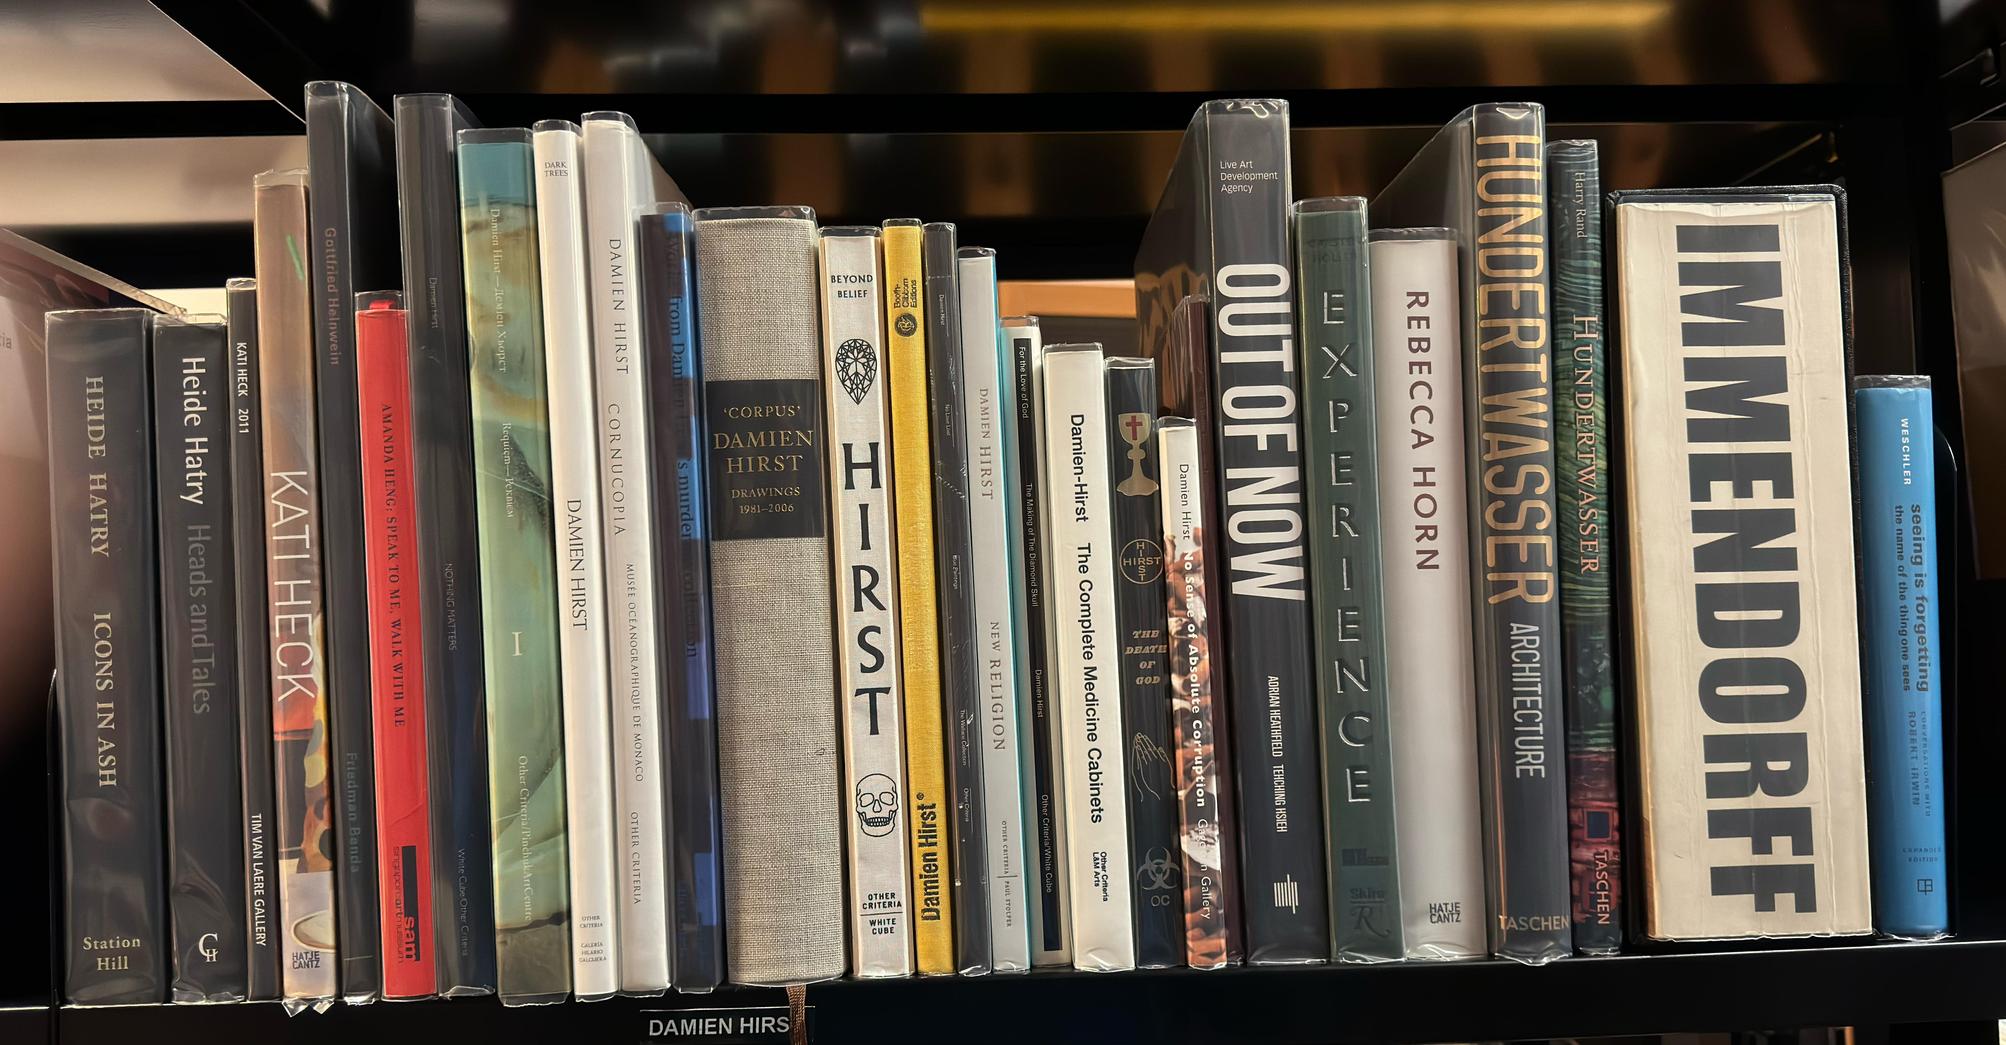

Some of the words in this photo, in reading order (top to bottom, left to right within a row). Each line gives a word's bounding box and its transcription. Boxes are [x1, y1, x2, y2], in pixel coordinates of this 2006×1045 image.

[544, 169, 568, 177] TREES
[1220, 161, 1237, 169] Live
[1240, 160, 1253, 169] Art
[1220, 172, 1278, 181] Development
[1221, 184, 1253, 194] Agency
[1573, 171, 1589, 206] Harry
[490, 208, 501, 246] Damien
[1575, 208, 1589, 239] Rand
[323, 227, 341, 293] Gottfried
[609, 238, 626, 312] DAMIEN
[831, 274, 873, 283] BEYOND
[838, 289, 868, 298] BELIEF
[667, 296, 683, 336] from
[1216, 263, 1293, 373] OUT
[236, 342, 248, 365] KATI
[613, 322, 629, 375] HIRST
[1018, 346, 1027, 359] For
[237, 368, 249, 397] HECK
[1019, 360, 1027, 373] the
[1020, 374, 1028, 392] Love
[1405, 291, 1436, 451] REBECCA
[1475, 134, 1554, 605] HUNDERTWASSER
[181, 357, 208, 427] Heide
[86, 375, 107, 459] HEIDE
[238, 408, 250, 434] 2011
[979, 388, 992, 439] DAMIEN
[1021, 403, 1029, 420] God
[1221, 385, 1298, 453] OF
[381, 403, 396, 463] AMANDA
[713, 430, 814, 450] DAMIEN
[1573, 314, 1600, 575] HUNDERTWASSER
[726, 455, 804, 474] HIRST
[1070, 413, 1089, 523] Damien-Hirst
[1900, 417, 1912, 486] WESCHLER
[179, 436, 209, 504] Hatry
[607, 403, 627, 537] CORNUCOPIA
[979, 446, 995, 500] HIRST
[1178, 464, 1192, 507] Damien
[385, 468, 399, 512] HENG:
[731, 486, 801, 499] DRAWINGS
[1025, 483, 1033, 498] The
[88, 472, 110, 558] HATRY
[271, 470, 312, 561] KATI
[1026, 499, 1035, 526] Making
[1181, 511, 1193, 540] Hirst
[1411, 465, 1441, 571] HORN
[1895, 504, 1907, 524] the
[386, 516, 400, 560] SPEAK
[566, 499, 585, 572] DAMIEN
[1028, 537, 1036, 551] The
[1225, 465, 1307, 602] NOW
[1321, 289, 1372, 804] EXPERIENCE
[1896, 528, 1907, 561] name
[1910, 503, 1927, 566] seeing
[187, 523, 214, 597] Heads
[388, 566, 402, 584] TO
[1029, 553, 1038, 587] Diamond
[1077, 542, 1092, 575] The
[1123, 556, 1161, 567] HIRST
[1183, 551, 1195, 571] No
[1675, 223, 1818, 914] IMMENDORFF
[1897, 564, 1909, 578] of
[443, 563, 456, 607] NOTHING
[842, 442, 892, 736] HIRST
[1185, 576, 1199, 618] Sense
[1898, 581, 1910, 600] the
[1914, 573, 1928, 588] is
[388, 588, 403, 614] ME,
[570, 577, 588, 631] HIRST
[1031, 588, 1039, 607] Skull
[189, 604, 215, 647] and
[446, 609, 458, 651] MATTERS
[990, 621, 1002, 652] NEW
[1079, 579, 1097, 661] Complete
[1132, 630, 1160, 639] THE
[1188, 623, 1200, 639] of
[1899, 605, 1912, 636] thing
[93, 612, 114, 691] ICONS
[274, 579, 316, 702] HECK
[390, 618, 405, 657] WALK
[1124, 644, 1168, 655] DEATH
[1901, 638, 1911, 660] one
[1914, 595, 1932, 692] forgetting
[391, 662, 406, 700] WITH
[1136, 676, 1160, 685] GOD
[1139, 660, 1156, 669] OF
[1189, 644, 1203, 713] Absolute
[1902, 664, 1912, 692] sees
[190, 652, 217, 714] Tales
[1035, 669, 1043, 699] Damien
[1266, 675, 1282, 707] ADRIAN
[96, 701, 117, 730] IN
[393, 706, 407, 728] ME
[990, 659, 1006, 751] RELIGION
[1036, 700, 1044, 718] Hirst
[1082, 665, 1100, 743] Medicine
[1509, 622, 1546, 779] ARCHITECTURE
[632, 715, 642, 729] DE
[1269, 709, 1285, 758] HEATHFIELD
[97, 736, 118, 788] ASH
[518, 755, 531, 785] Other
[633, 733, 645, 783] MONACO
[1192, 719, 1207, 807] Corruption
[346, 752, 361, 821] Friedman
[1086, 747, 1104, 824] Cabinets
[1272, 763, 1287, 806] TEHCHING
[250, 813, 263, 834] TIM
[630, 811, 641, 848] OTHER
[1001, 820, 1009, 842] OTHER
[1274, 807, 1289, 834] HSIEH
[251, 836, 264, 860] VAN
[349, 826, 364, 873] Banda
[1002, 844, 1010, 875] CRITERIA
[1041, 794, 1049, 816] Other
[1045, 872, 1053, 893] Cube
[631, 851, 643, 905] CRITERIA
[1099, 851, 1108, 872] Other
[252, 862, 265, 896] LAERE
[918, 852, 940, 922] Damien
[1003, 880, 1012, 897] PAUL
[1101, 874, 1109, 902] Criteria
[1594, 851, 1611, 926] TASCHEN
[862, 900, 902, 910] CRITERIA
[867, 892, 896, 900] OTHER
[1150, 895, 1170, 907] OC
[1200, 876, 1213, 920] Gallery
[1429, 902, 1461, 913] HATJE
[254, 899, 267, 946] GALLERY
[869, 918, 897, 927] WHITE
[1004, 899, 1013, 928] STOLPER
[1430, 912, 1461, 924] CANTZ
[1499, 915, 1569, 931] TASCHEN
[83, 936, 141, 950] Station
[404, 916, 417, 961] sam
[872, 927, 895, 935] CUBE
[97, 956, 129, 970] Hill
[292, 951, 320, 960] HATJE
[292, 960, 320, 969] CANTZ
[649, 1017, 732, 1036] DAMIEN
